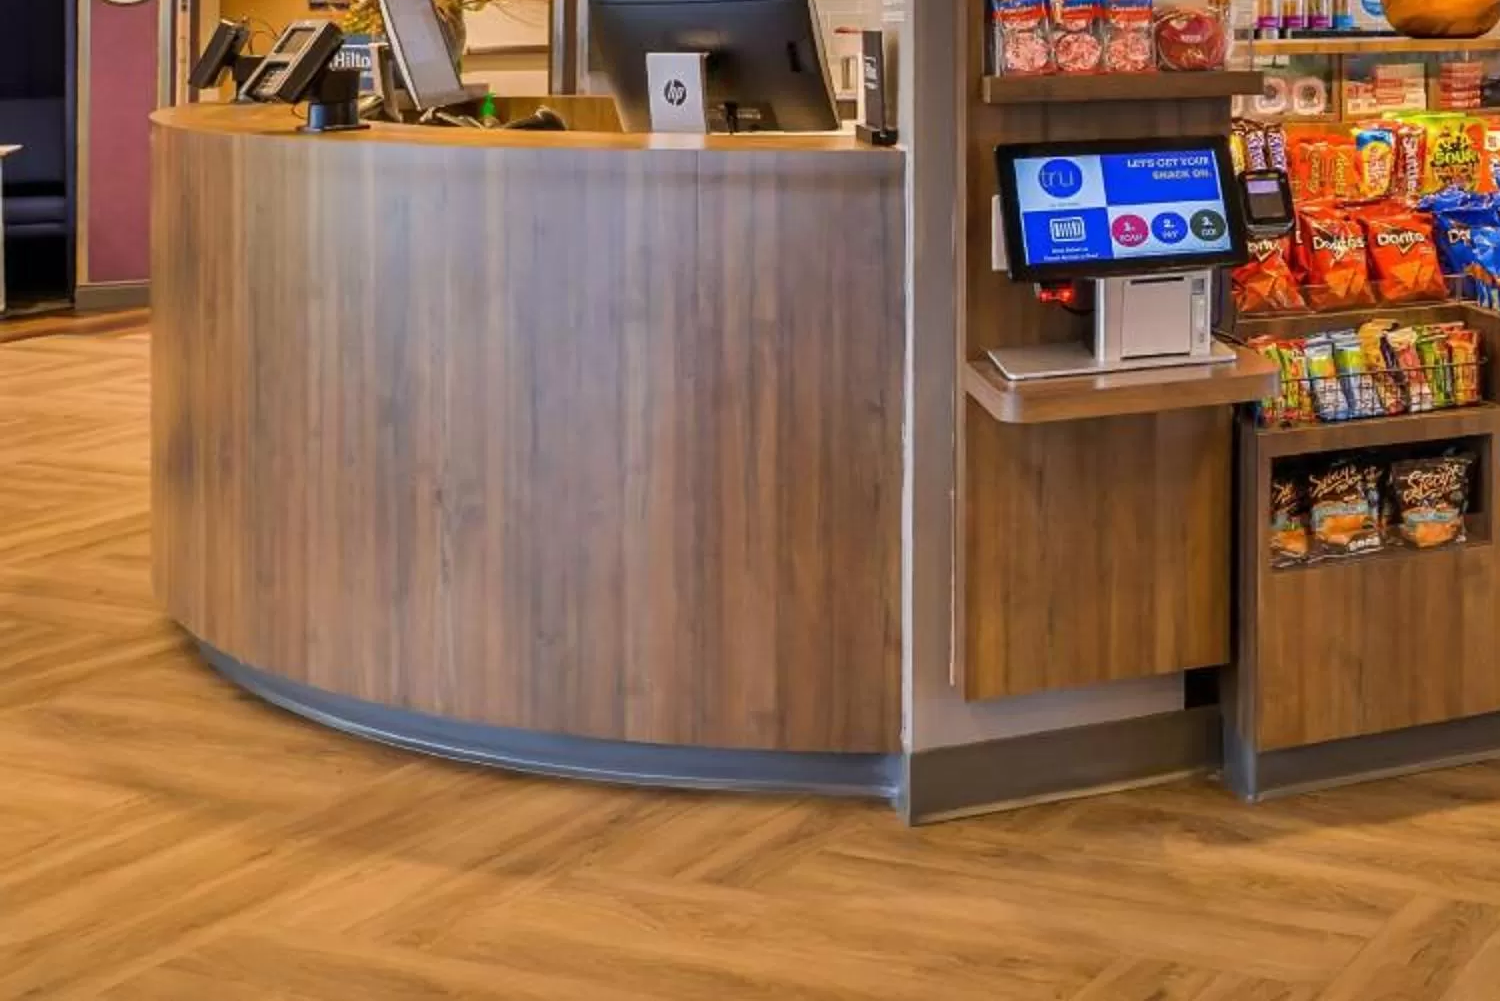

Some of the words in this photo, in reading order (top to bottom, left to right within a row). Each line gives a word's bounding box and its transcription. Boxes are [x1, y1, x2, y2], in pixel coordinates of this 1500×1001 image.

[334, 51, 370, 68] Hilto
[664, 79, 687, 106] hp
[1041, 170, 1075, 189] tru
